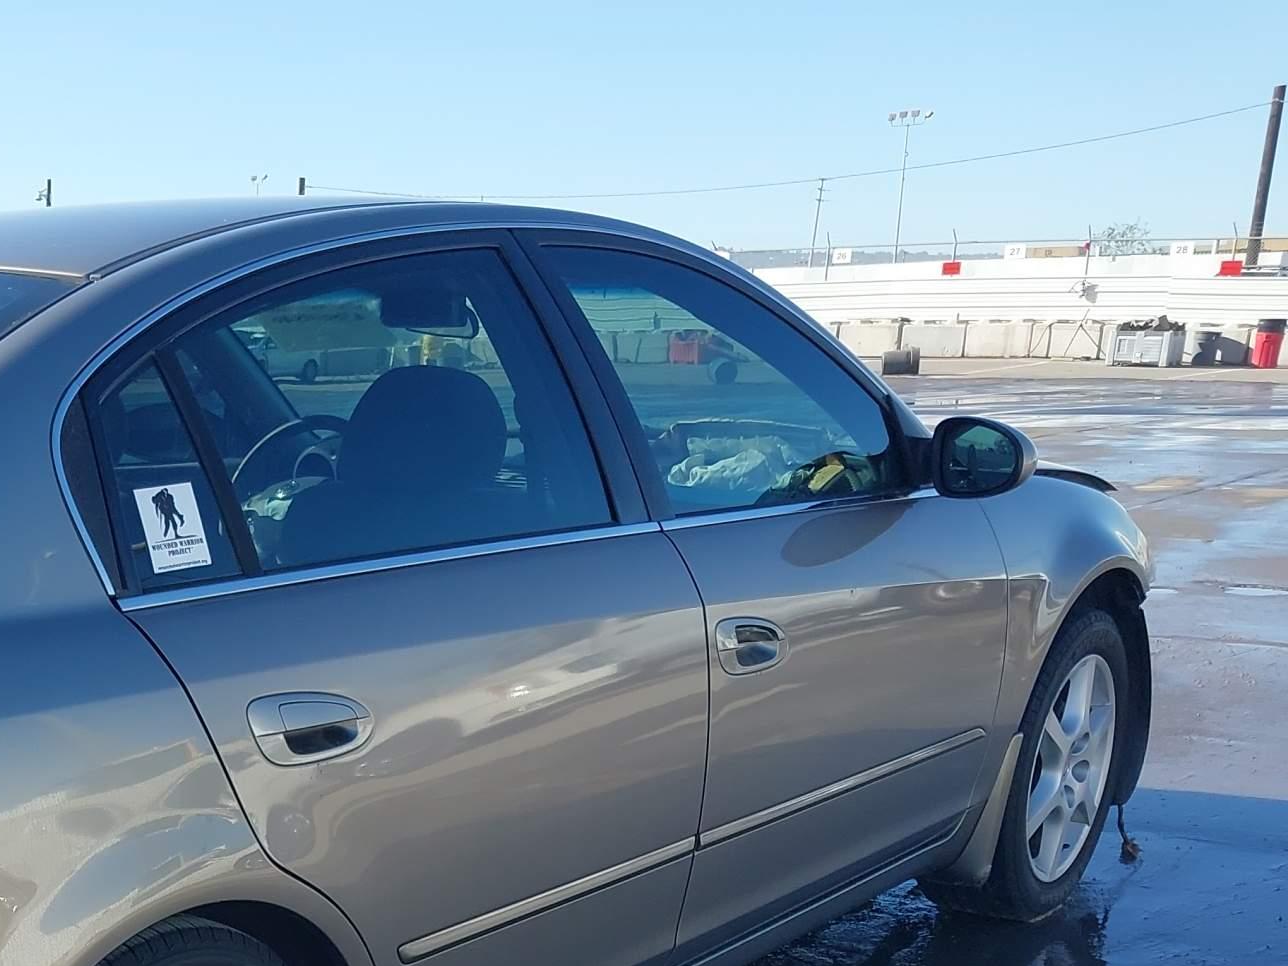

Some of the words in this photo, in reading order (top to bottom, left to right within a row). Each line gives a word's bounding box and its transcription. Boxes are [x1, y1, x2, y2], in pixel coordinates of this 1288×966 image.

[1009, 247, 1021, 256] 27
[152, 542, 178, 551] WOUNDED
[179, 538, 204, 547] WARRIOR
